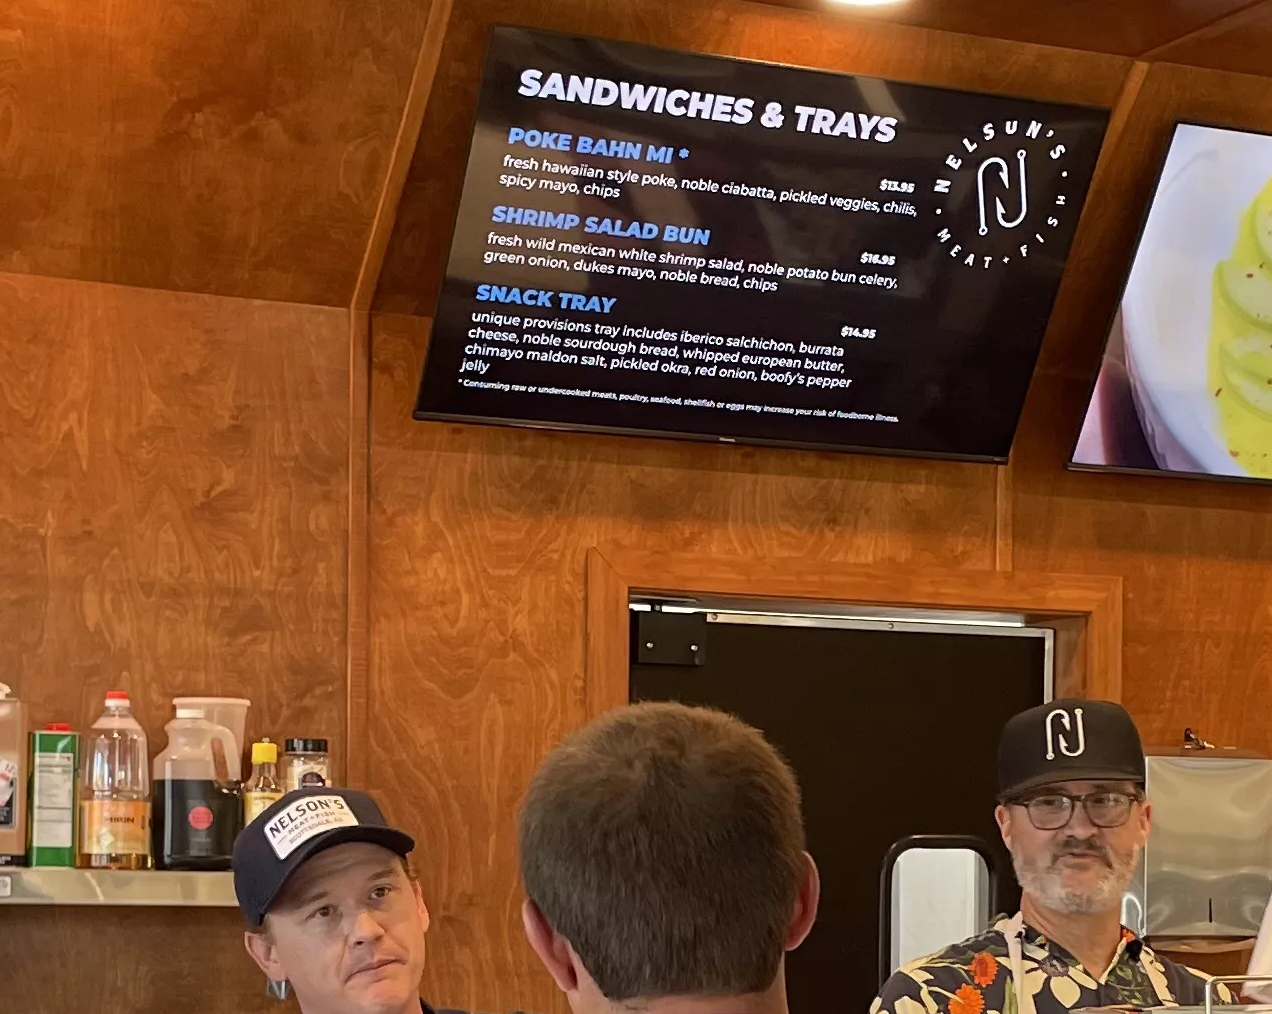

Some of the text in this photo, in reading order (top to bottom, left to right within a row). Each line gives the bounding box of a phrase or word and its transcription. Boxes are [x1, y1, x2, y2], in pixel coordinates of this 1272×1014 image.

[517, 69, 897, 142] SANDWICHES & TRAYS
[508, 127, 673, 163] POKE BAHN MI
[499, 172, 620, 198] spicy mayo, chips
[503, 154, 916, 217] fresh hawaiian style poke, noble ciabatta, pickled veggies, chilis,
[491, 205, 710, 245] SHRIMP SALAD BUN
[487, 231, 897, 289] fresh wild mexican white shrimp salad, noble potato bun celery,
[937, 228, 992, 268] MEAT
[483, 251, 777, 292] green onion, dukes mayo, noble bread, chips
[475, 284, 616, 313] SNACK TRAY
[467, 326, 844, 373] cheese, noble sourdough bread, whipped european butter,
[471, 311, 844, 356] unique provisions tray includes iberico salchichon, burrata
[840, 325, 876, 338] $14.95
[458, 357, 490, 374] jelly
[464, 342, 852, 388] chimayo maldon salt, pickled okra, red onion, boofy's pepper
[827, 409, 836, 417] of
[269, 799, 345, 838] NELSON'S
